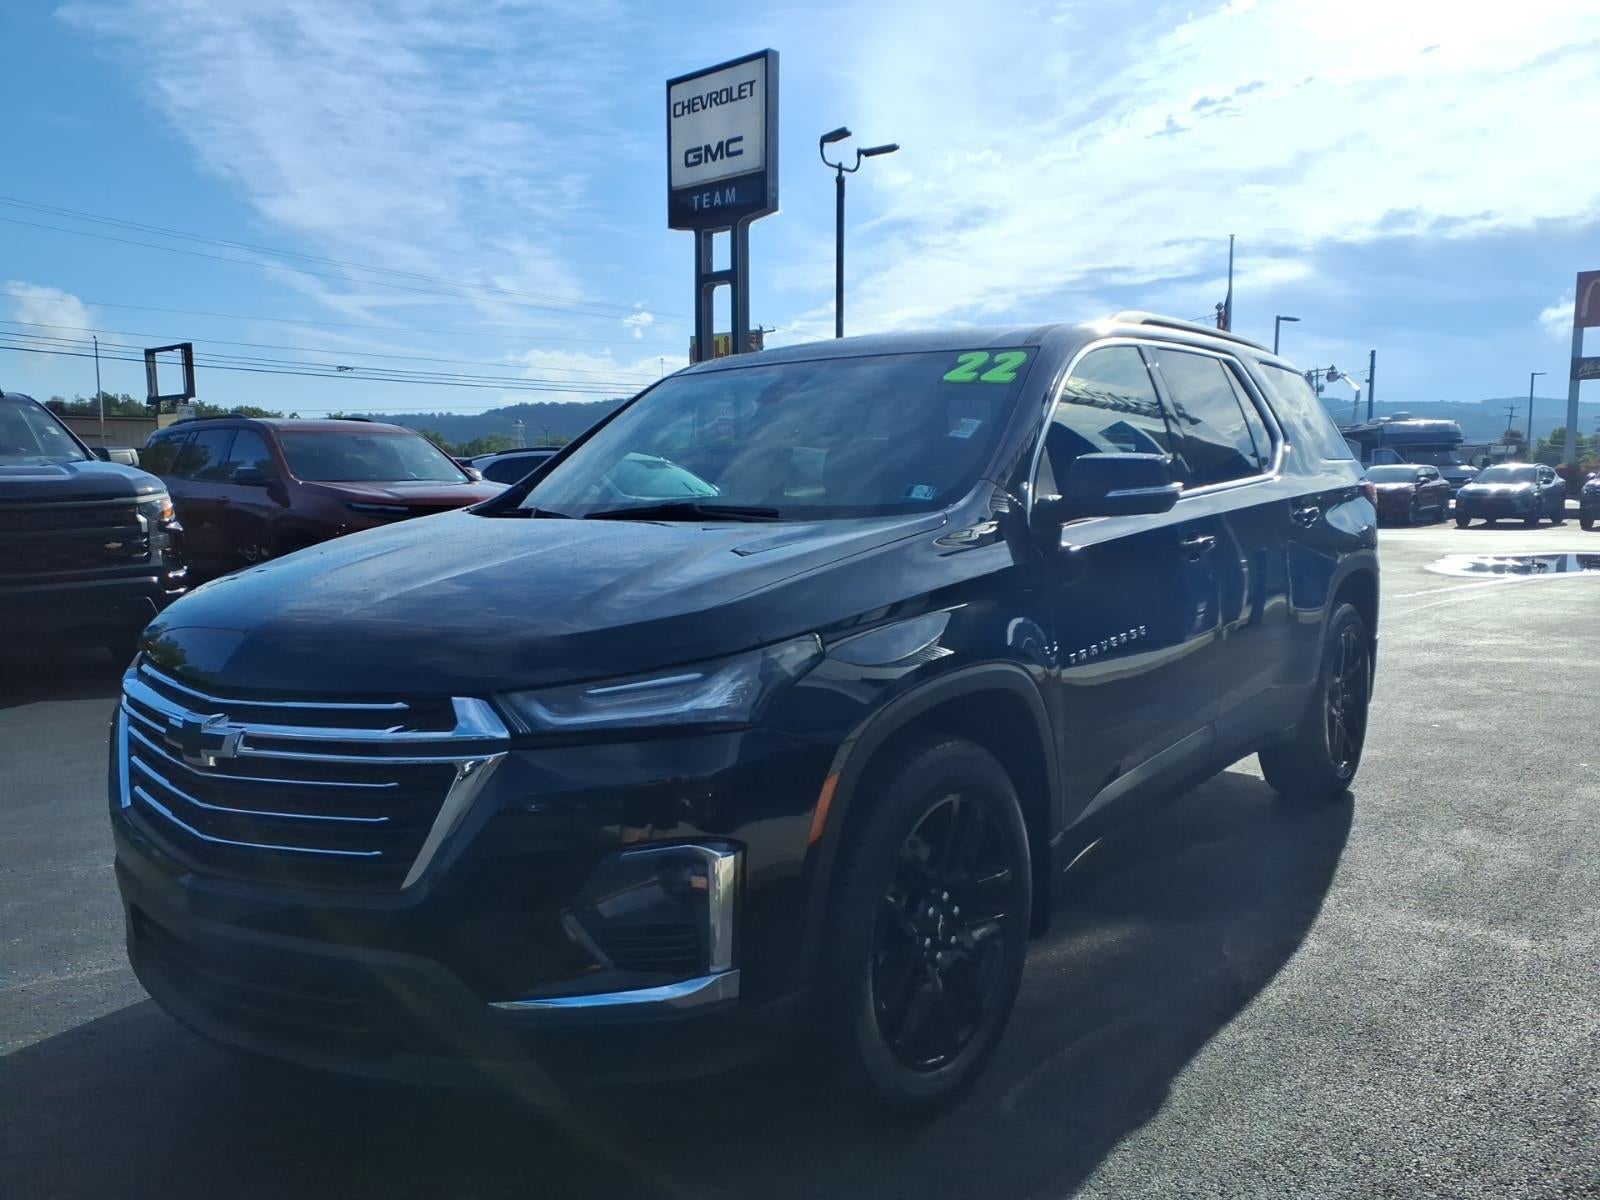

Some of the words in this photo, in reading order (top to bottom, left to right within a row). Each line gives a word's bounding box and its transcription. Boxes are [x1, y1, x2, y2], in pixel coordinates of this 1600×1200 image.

[673, 79, 756, 118] CHEVROLET
[684, 135, 743, 168] GMC
[692, 187, 736, 211] TEAM
[943, 351, 1027, 383] 22
[1069, 625, 1147, 664] TRAVERSE
